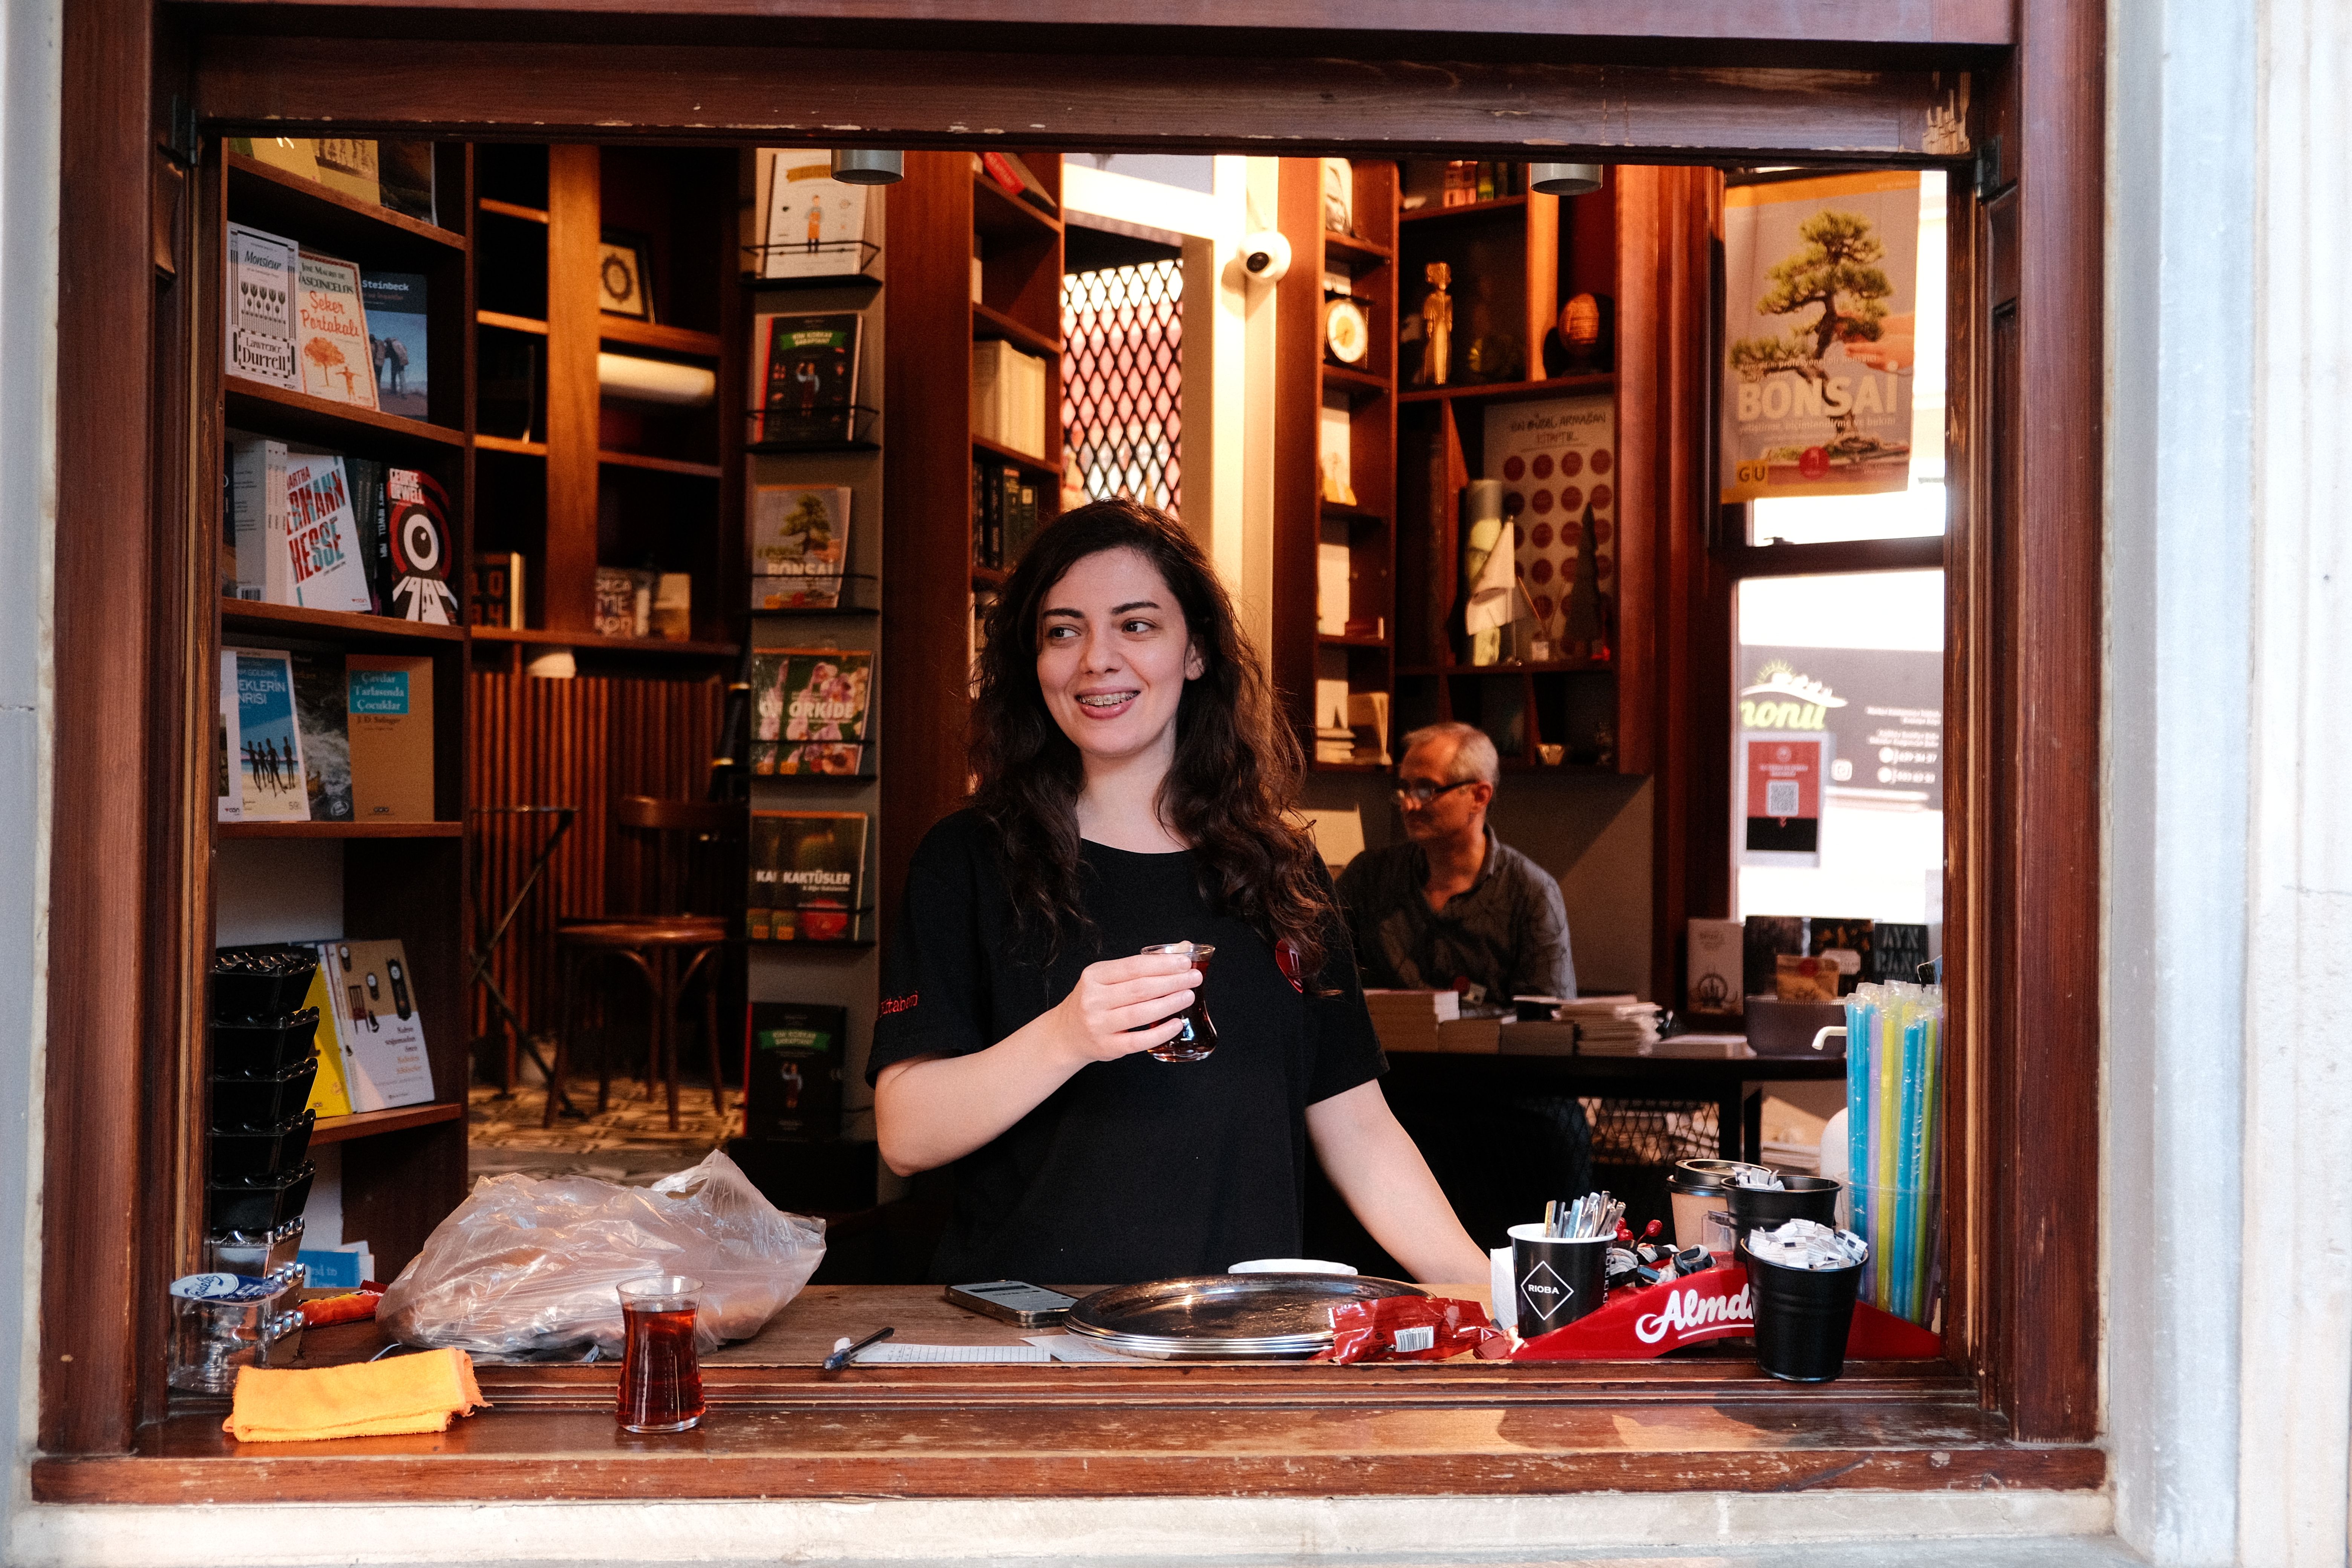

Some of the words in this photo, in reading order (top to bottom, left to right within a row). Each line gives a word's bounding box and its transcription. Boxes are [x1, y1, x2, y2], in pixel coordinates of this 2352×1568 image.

[244, 250, 282, 270] Monsieur
[362, 279, 409, 291] Steinbeck
[309, 290, 345, 314] Şeker
[300, 309, 360, 337] Portakalı
[246, 337, 282, 354] Lawrence
[242, 346, 286, 372] Durrell
[1738, 360, 1899, 421] BONSAİ
[287, 466, 311, 491] ARTHA
[288, 515, 345, 584] HESSE
[238, 678, 286, 693] EKLERİN
[356, 699, 401, 712] Çocuklar
[789, 698, 854, 718] ORKİDE
[783, 868, 851, 885] KAKTÜSLER
[1528, 1284, 1560, 1295] RIOBA
